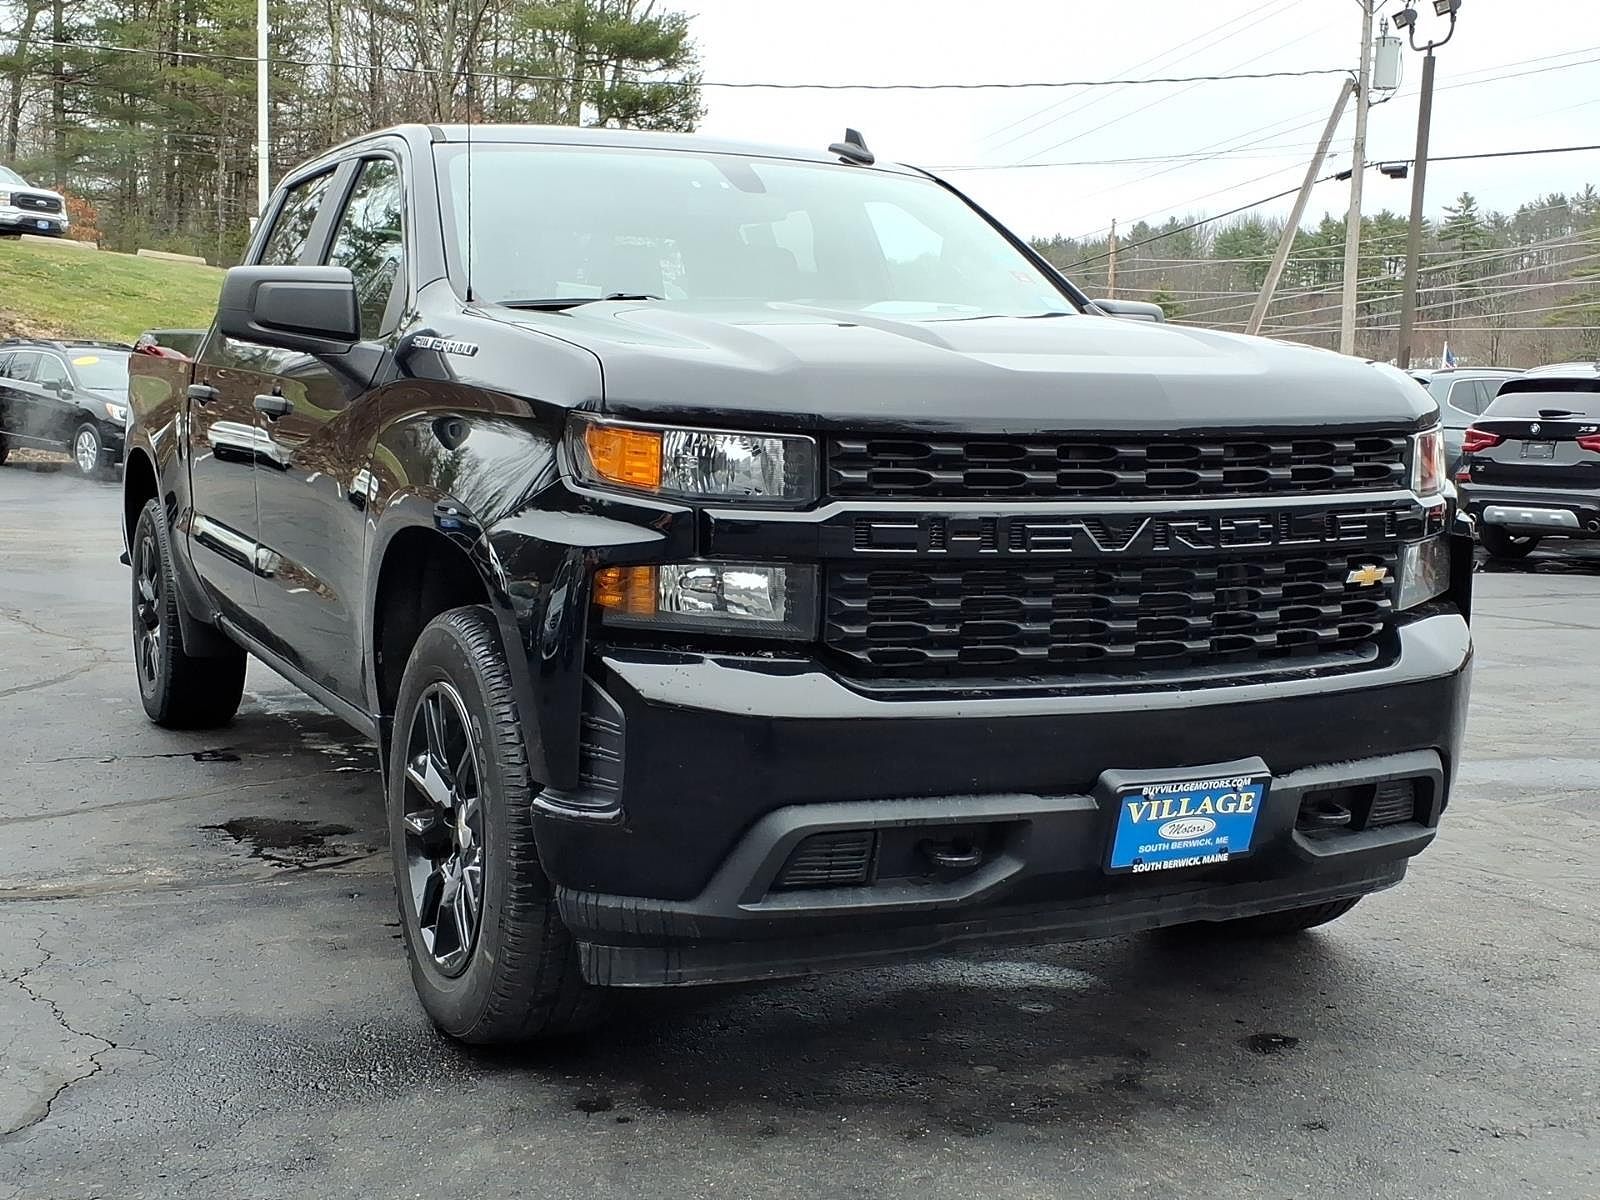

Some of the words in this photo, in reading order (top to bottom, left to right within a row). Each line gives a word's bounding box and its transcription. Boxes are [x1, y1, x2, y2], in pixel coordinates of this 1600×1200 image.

[851, 507, 1413, 553] CHEVROLET
[1142, 777, 1252, 796] BUYVILLAGEMOTORS.COM
[1127, 792, 1256, 824] VILLAGE
[1168, 822, 1206, 836] Motors
[1138, 842, 1170, 854] SOUTH
[1215, 836, 1229, 845] ME
[1132, 861, 1162, 873] SOUTH
[1201, 853, 1229, 864] MAINE
